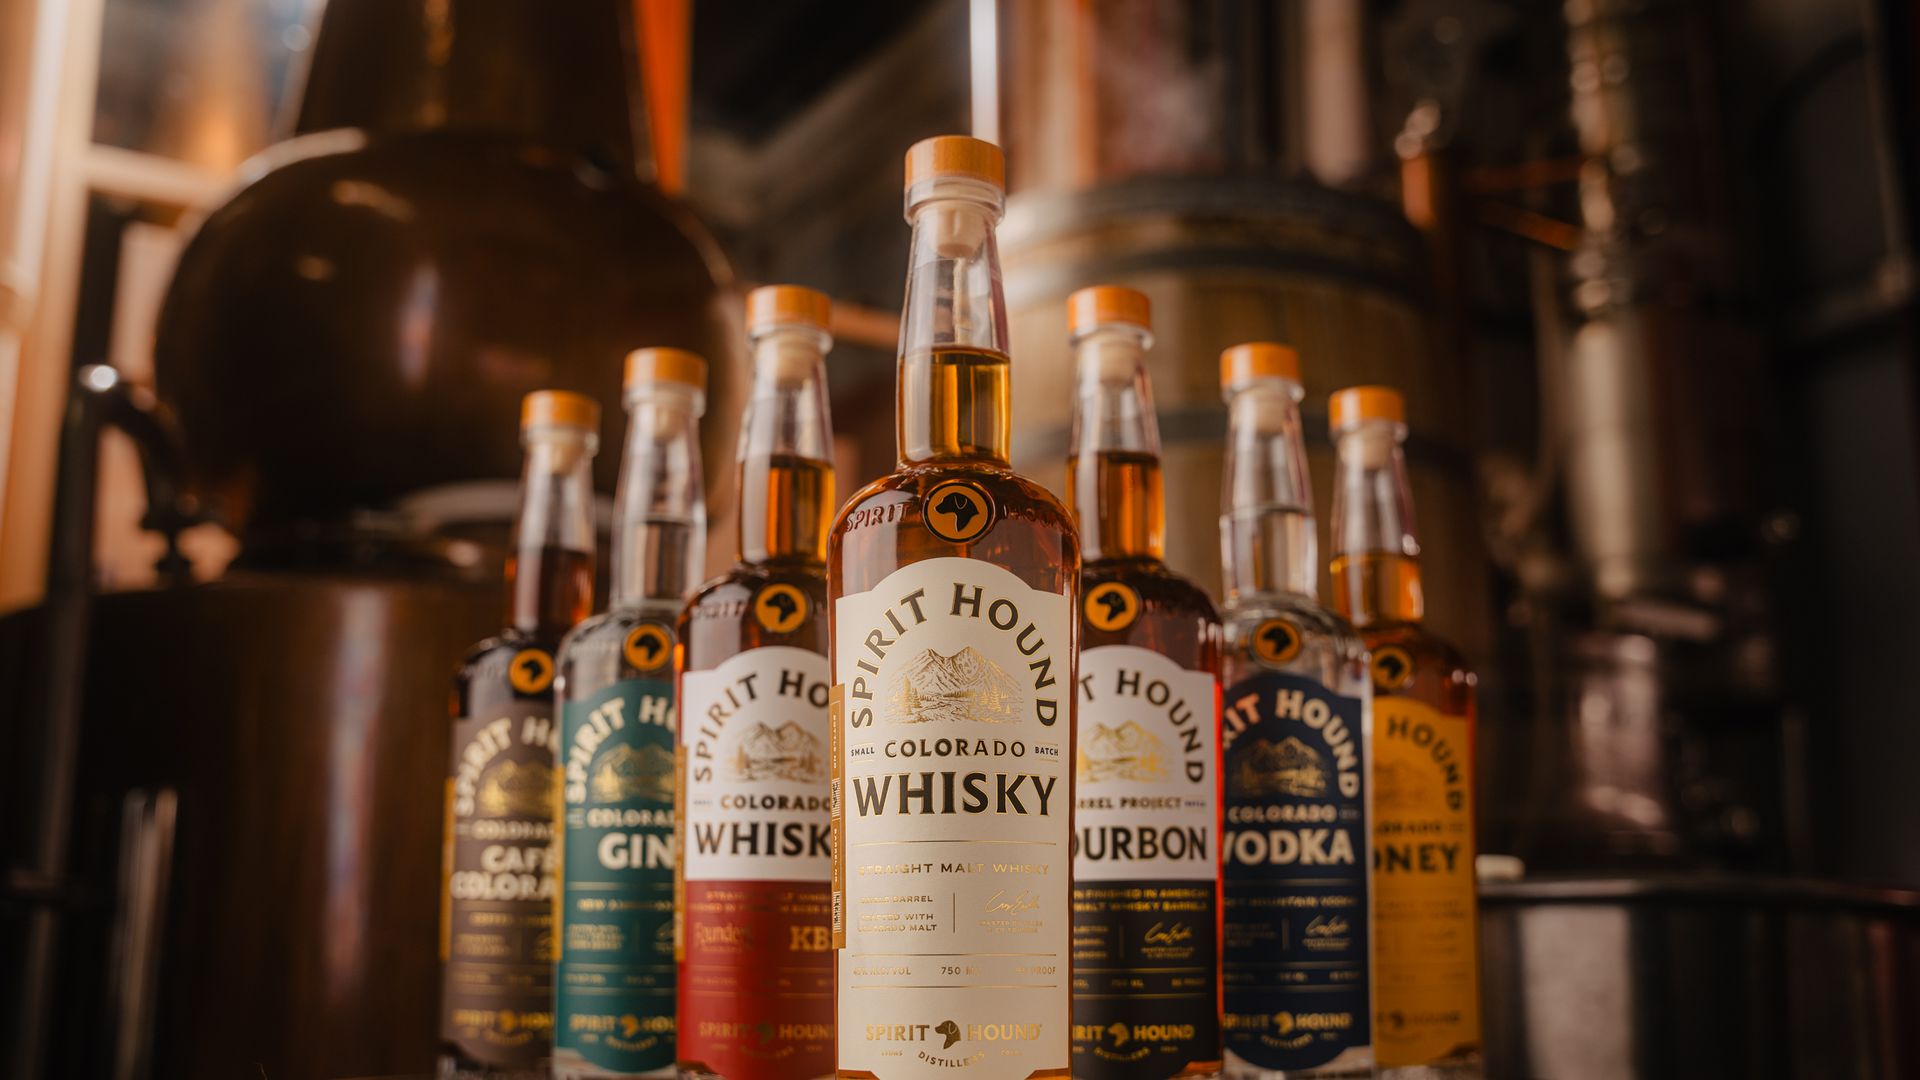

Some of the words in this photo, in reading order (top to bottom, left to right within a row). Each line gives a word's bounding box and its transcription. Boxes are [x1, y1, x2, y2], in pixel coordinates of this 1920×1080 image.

[845, 502, 912, 532] SPIRIT
[851, 587, 928, 729] SPIRIT
[949, 582, 1058, 727] HOUND
[694, 672, 758, 782] SPIRIT
[1115, 668, 1205, 783] HOUND
[851, 745, 875, 757] SMALL
[884, 738, 1026, 758] COLORADO
[1034, 745, 1059, 757] BATCH
[1274, 688, 1360, 798] HOUND
[1387, 716, 1465, 812] HOUND
[852, 771, 1057, 817] WHISKY
[1120, 796, 1182, 809] PROJECT
[1227, 804, 1338, 823] COLORADO
[694, 821, 832, 856] WHISK
[1075, 826, 1207, 861] URBON
[597, 832, 675, 870] GIN
[858, 863, 933, 876] STRAIGHT
[940, 862, 985, 873] MALT
[992, 863, 1049, 875] WHISKY
[892, 895, 933, 903] BARREL
[905, 913, 934, 921] WITH
[909, 924, 937, 932] MALT
[789, 925, 831, 952] KB
[941, 966, 961, 975] 750
[778, 1023, 834, 1040] HOUN
[865, 1023, 930, 1041] SPIRIT
[967, 1023, 1041, 1041] HOUND
[1133, 1024, 1195, 1041] HOUND
